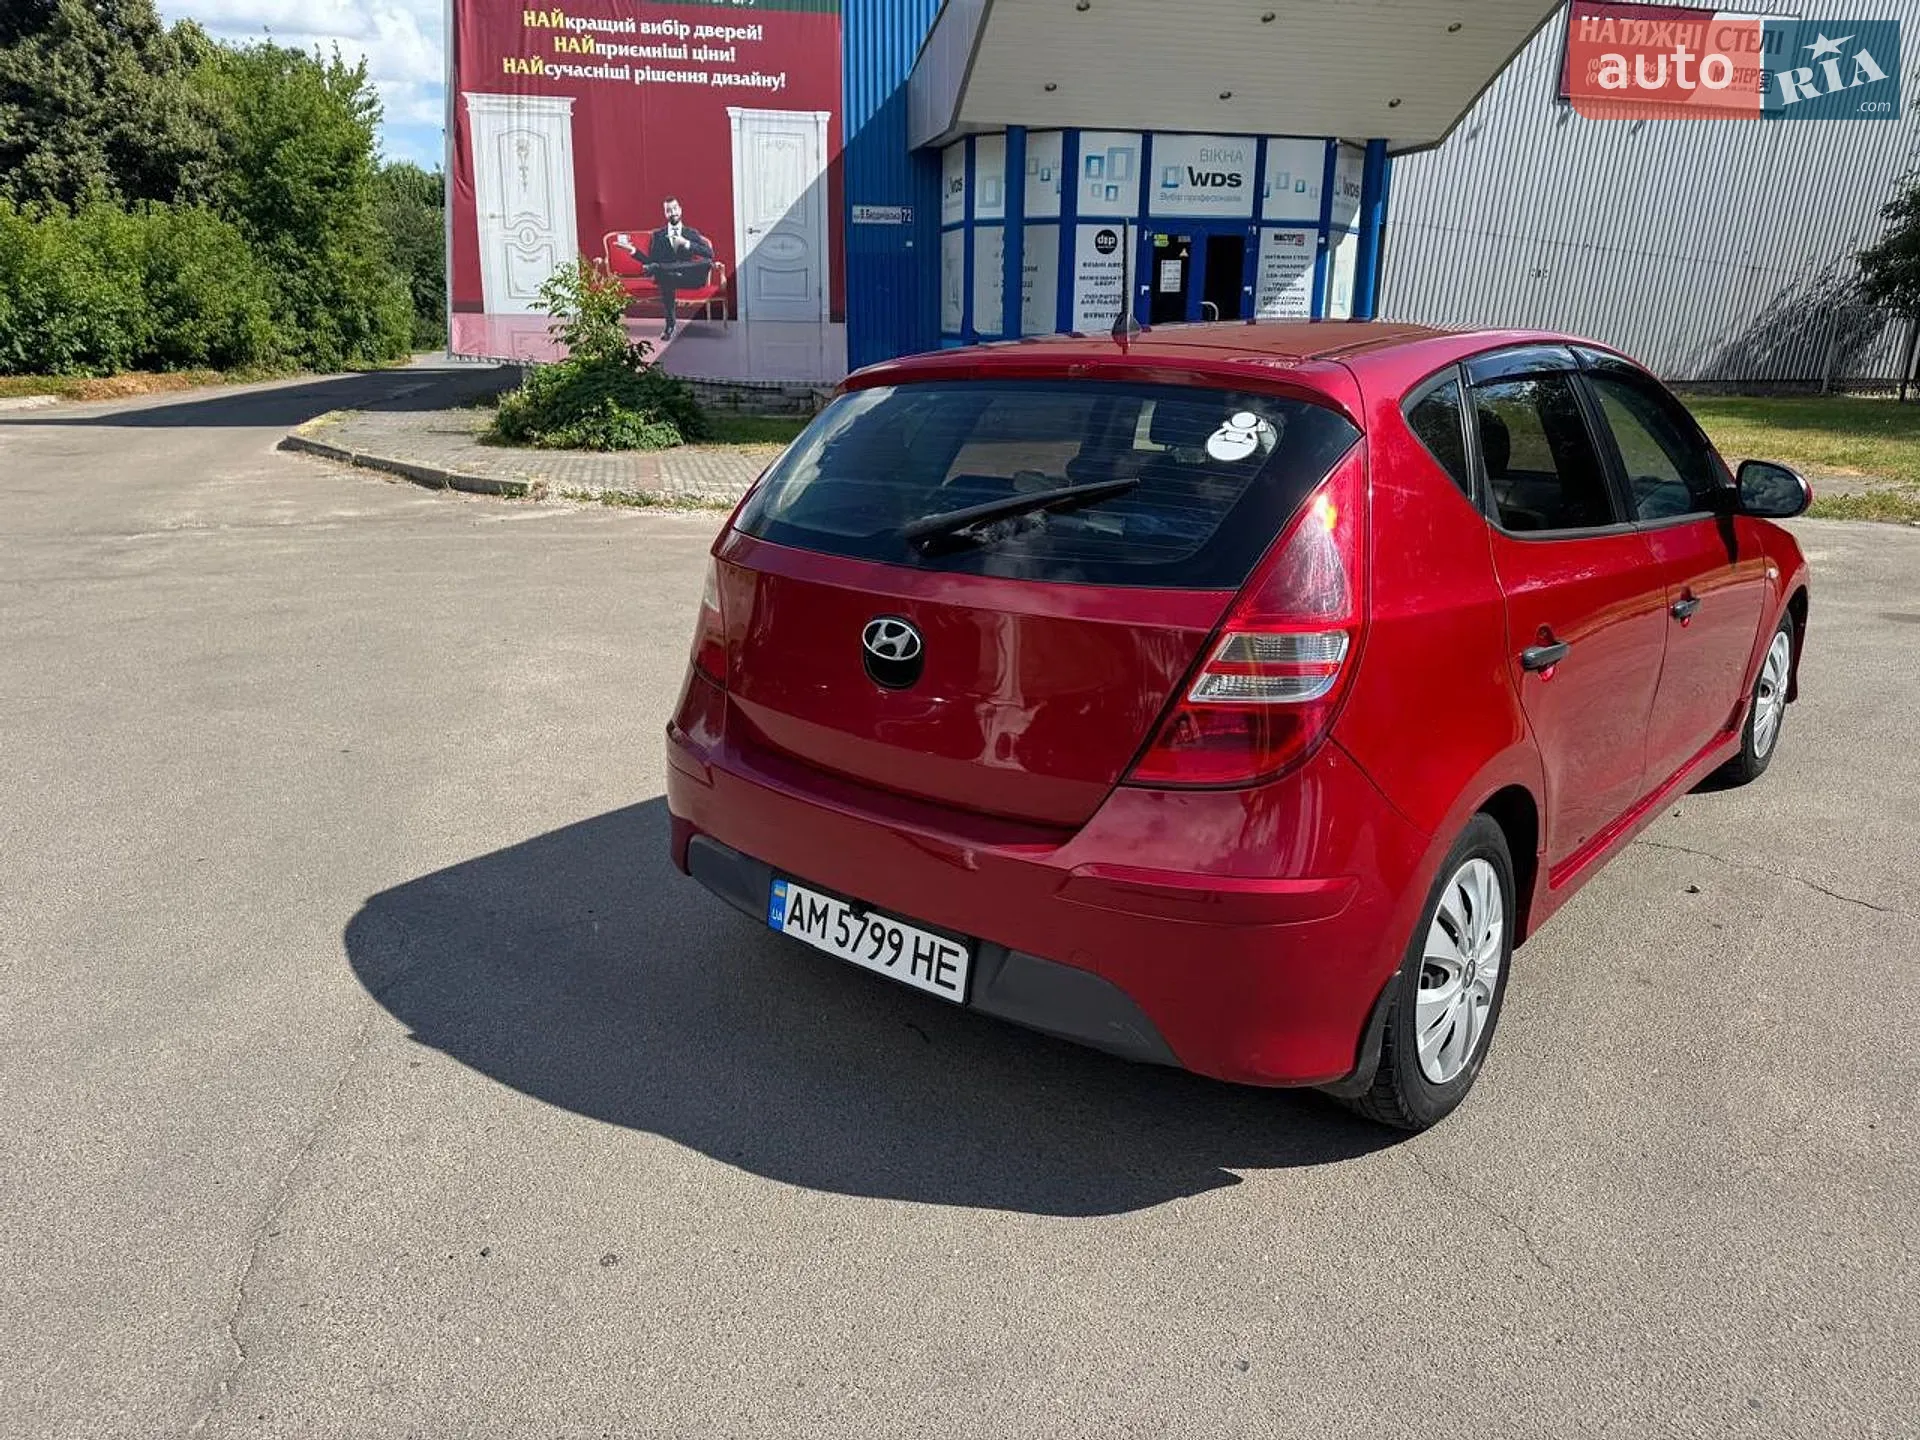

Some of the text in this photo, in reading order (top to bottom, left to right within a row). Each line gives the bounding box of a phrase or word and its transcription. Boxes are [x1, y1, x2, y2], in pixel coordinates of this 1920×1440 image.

[523, 9, 763, 42] НАЙкращий вибір дверей!
[1579, 15, 1784, 55] НАТЯЖНІ СТЕЛІ
[553, 35, 736, 63] НАЙприємніші ціни!
[502, 56, 786, 89] НАЙсучасніші рішення дизайну!
[1713, 66, 1758, 84] МСТЕР
[1199, 149, 1244, 163] ВІКНА
[1187, 166, 1242, 188] WDS
[787, 892, 960, 991] AM 5799 HE
